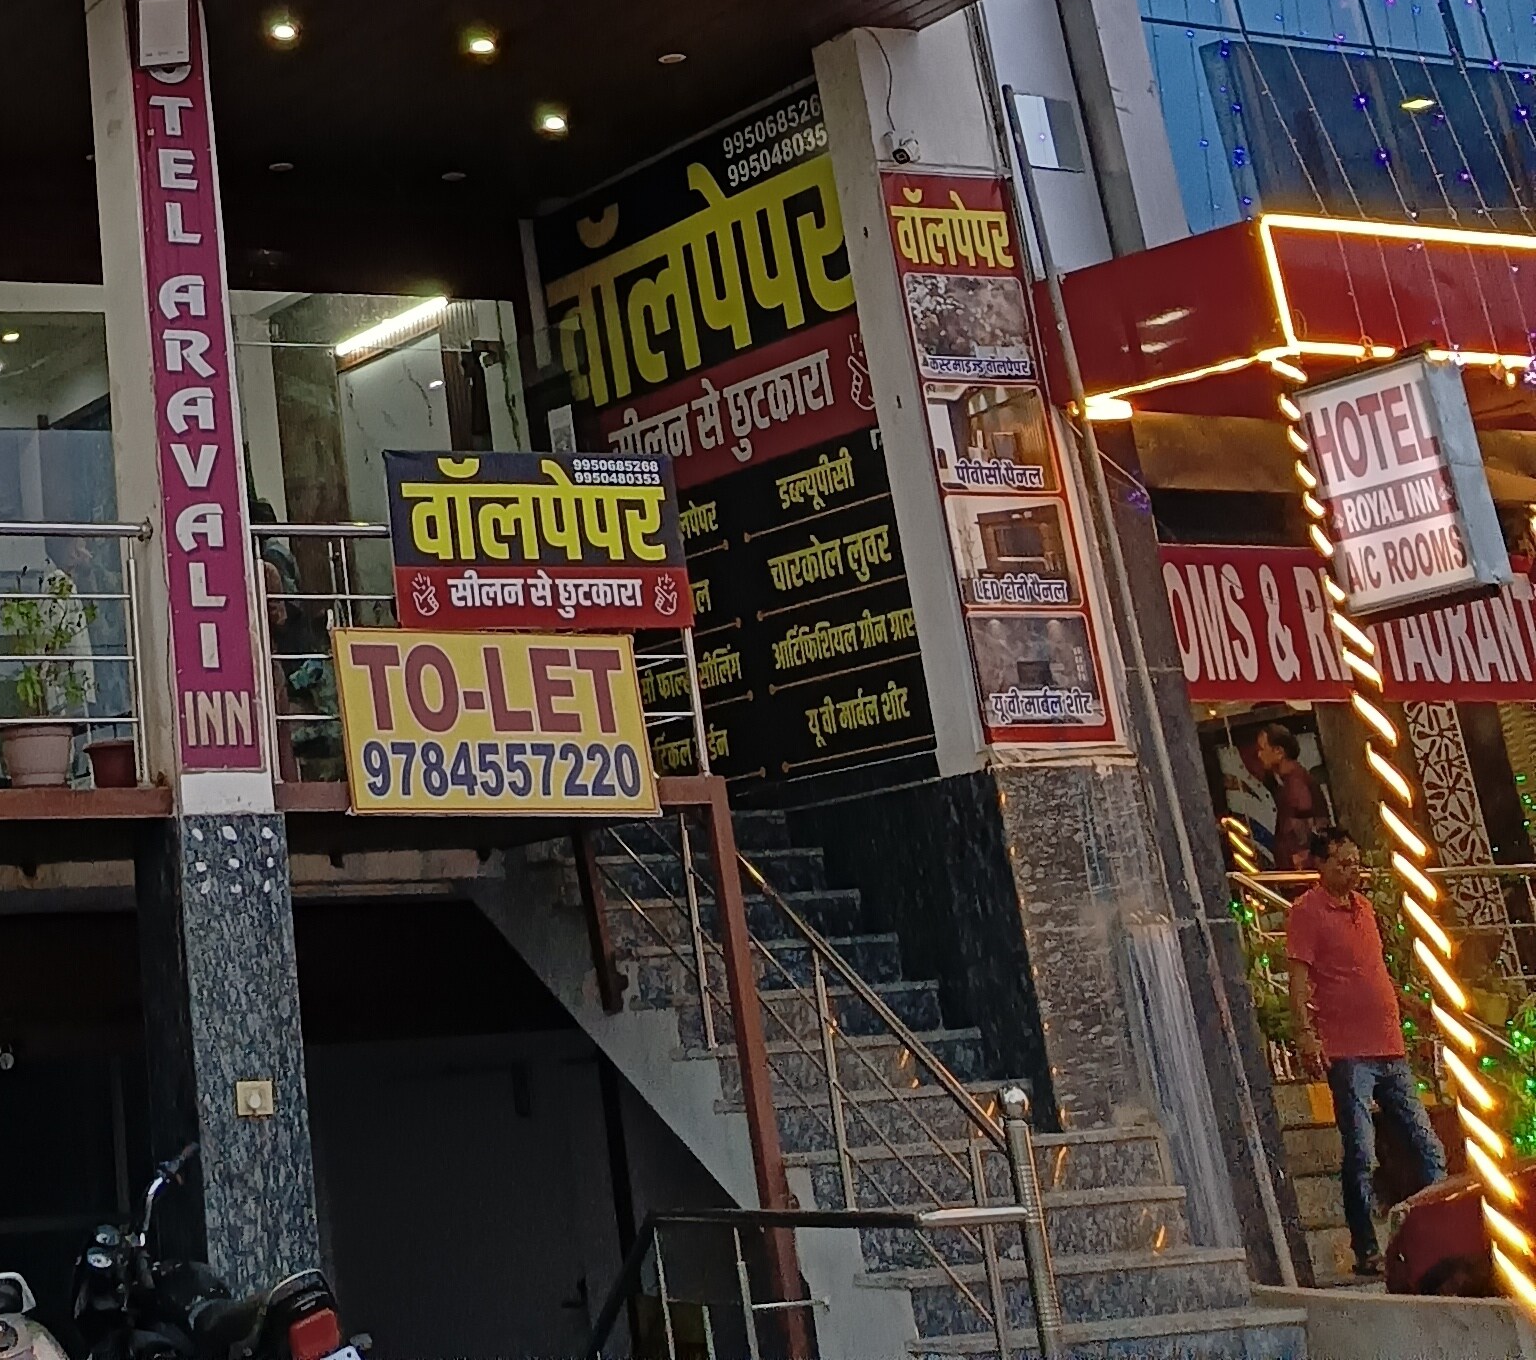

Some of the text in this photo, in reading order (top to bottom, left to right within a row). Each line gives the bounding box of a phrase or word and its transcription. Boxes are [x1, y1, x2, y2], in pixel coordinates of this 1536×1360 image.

[890, 187, 1015, 268] वॉलपेपर
[149, 64, 227, 669] TEL ARAVALI
[690, 377, 724, 450] से
[723, 349, 834, 462] छुटकारा
[1305, 383, 1441, 486] HOTEL
[401, 458, 667, 561] वॉलपेपर
[954, 458, 1003, 486] पीवीसी
[1342, 477, 1440, 534] ROYAL INN
[447, 569, 643, 618] सीलन से छुटकारा
[974, 579, 1001, 602] LED
[1346, 524, 1468, 595] A/C ROOMS
[1260, 564, 1300, 682] &
[184, 691, 252, 746] INN
[351, 643, 622, 734] TO-LET
[364, 741, 641, 798] 9784557220
